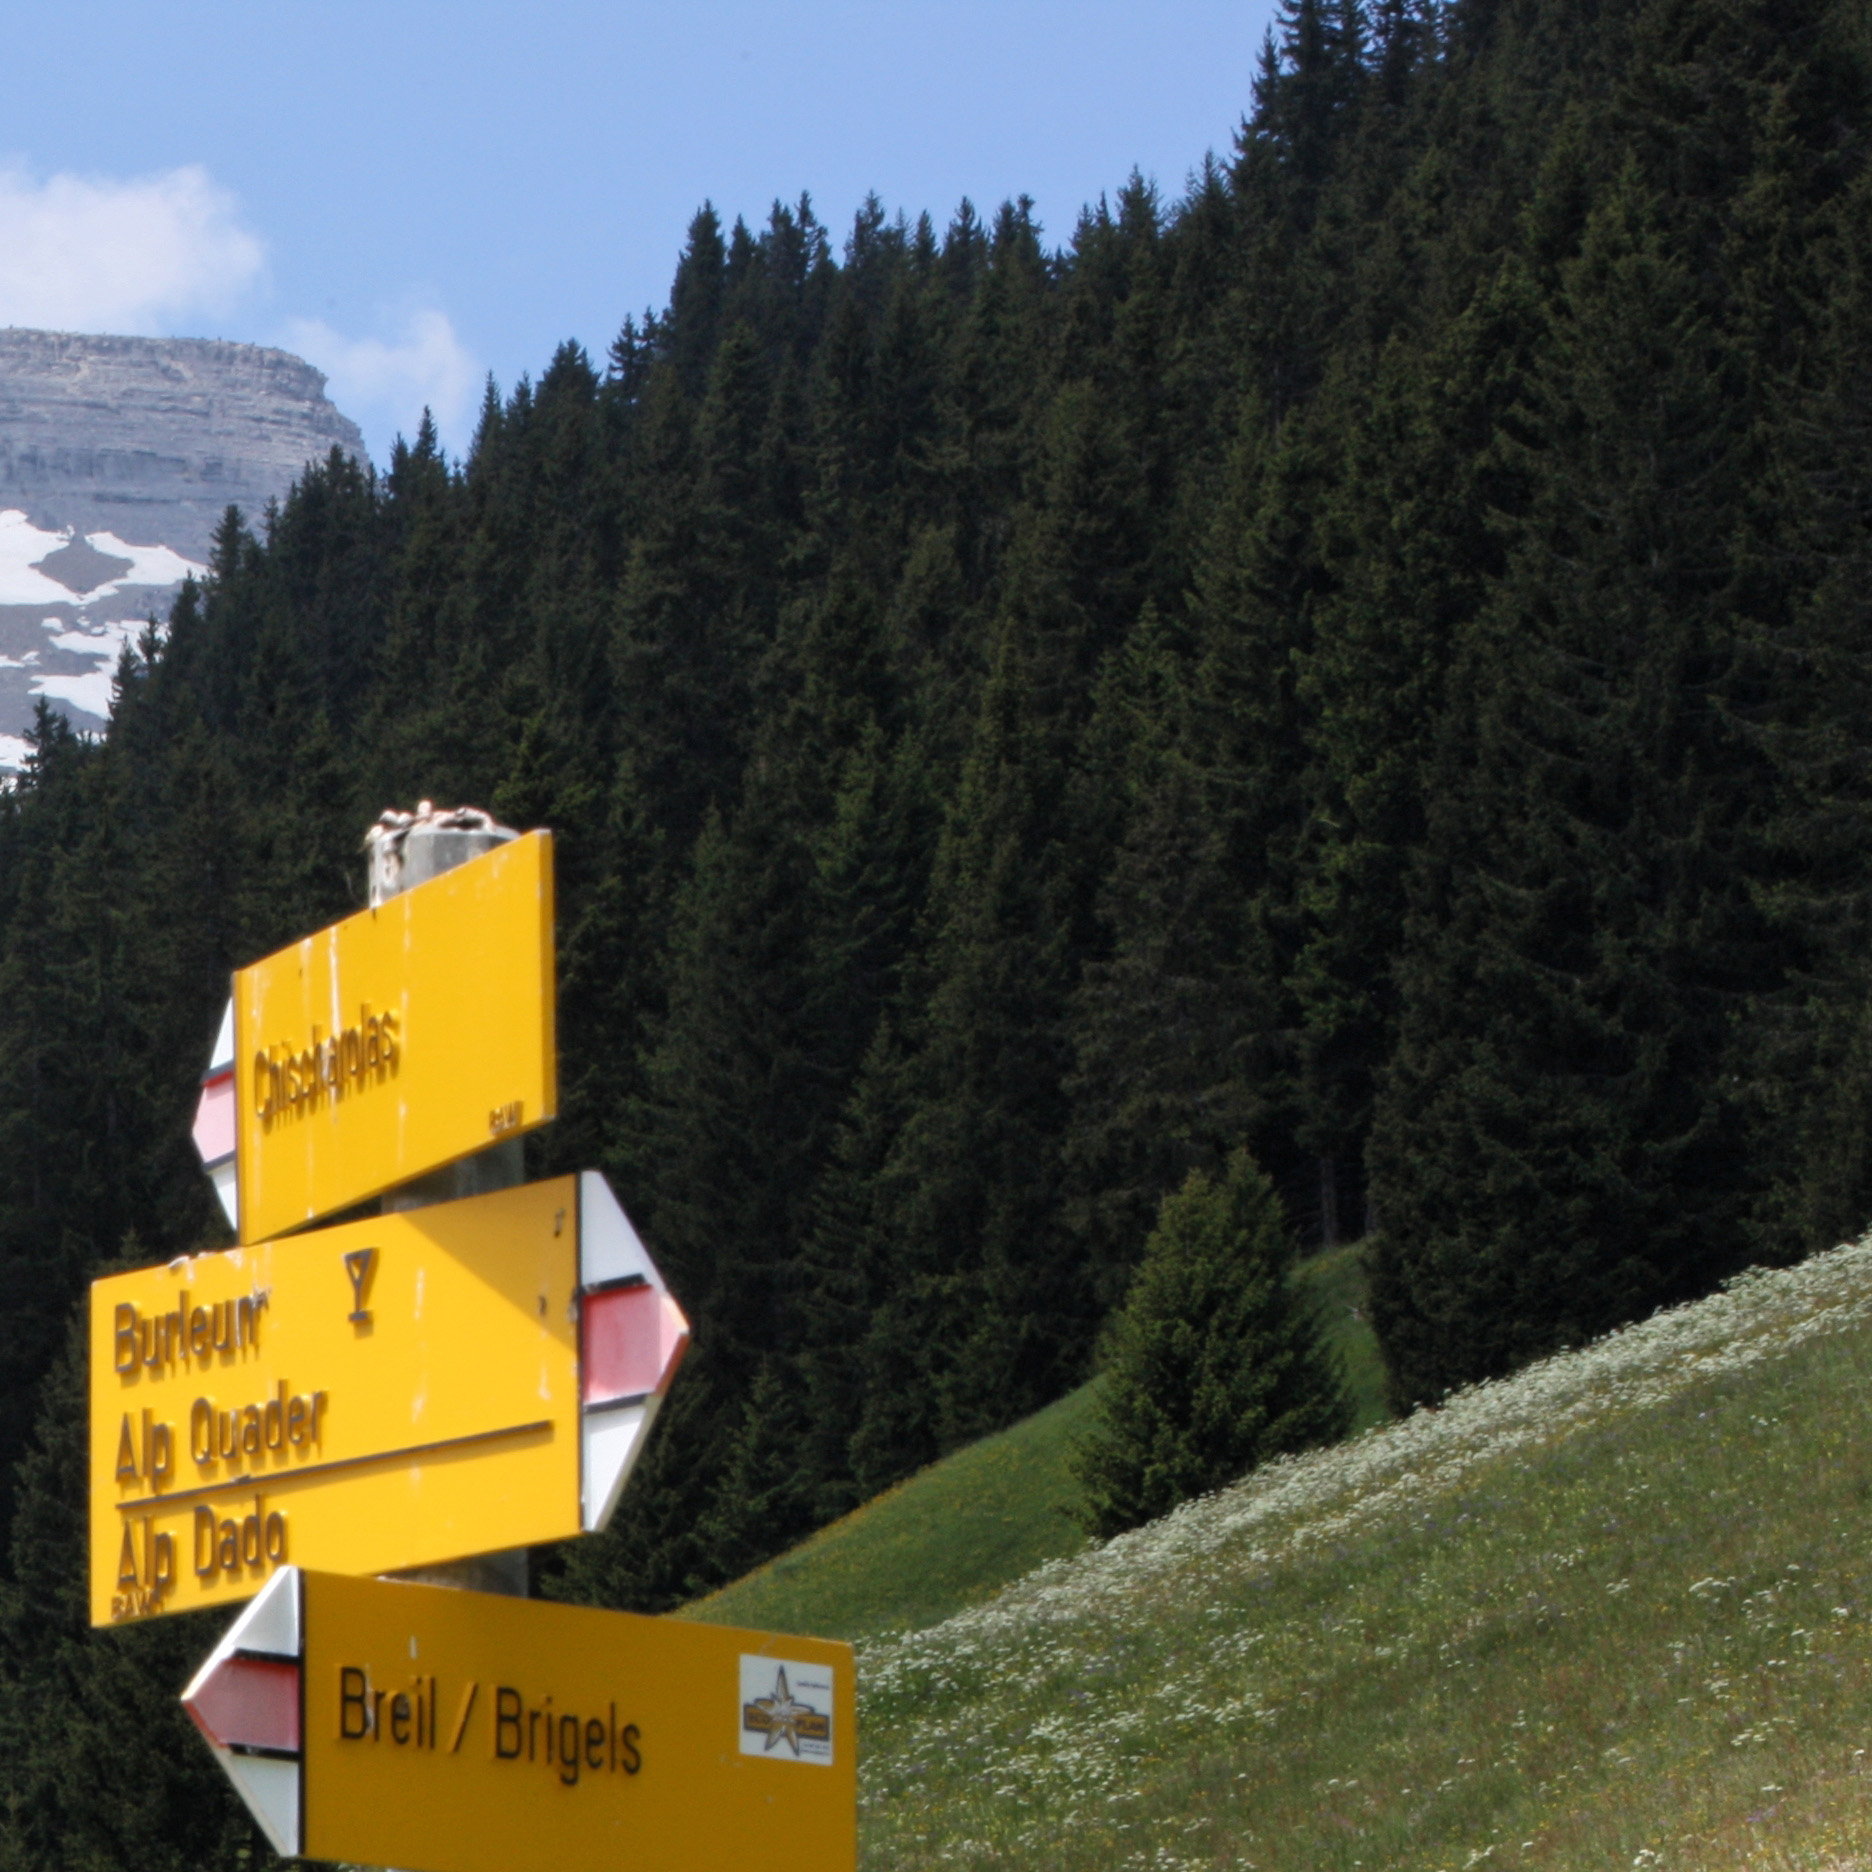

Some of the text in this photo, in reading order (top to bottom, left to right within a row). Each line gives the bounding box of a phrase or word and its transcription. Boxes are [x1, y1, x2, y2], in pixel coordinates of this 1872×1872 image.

[115, 1379, 327, 1495] Alp Quader
[116, 1494, 285, 1602] Alp Dado
[494, 1686, 642, 1786] Brigels
